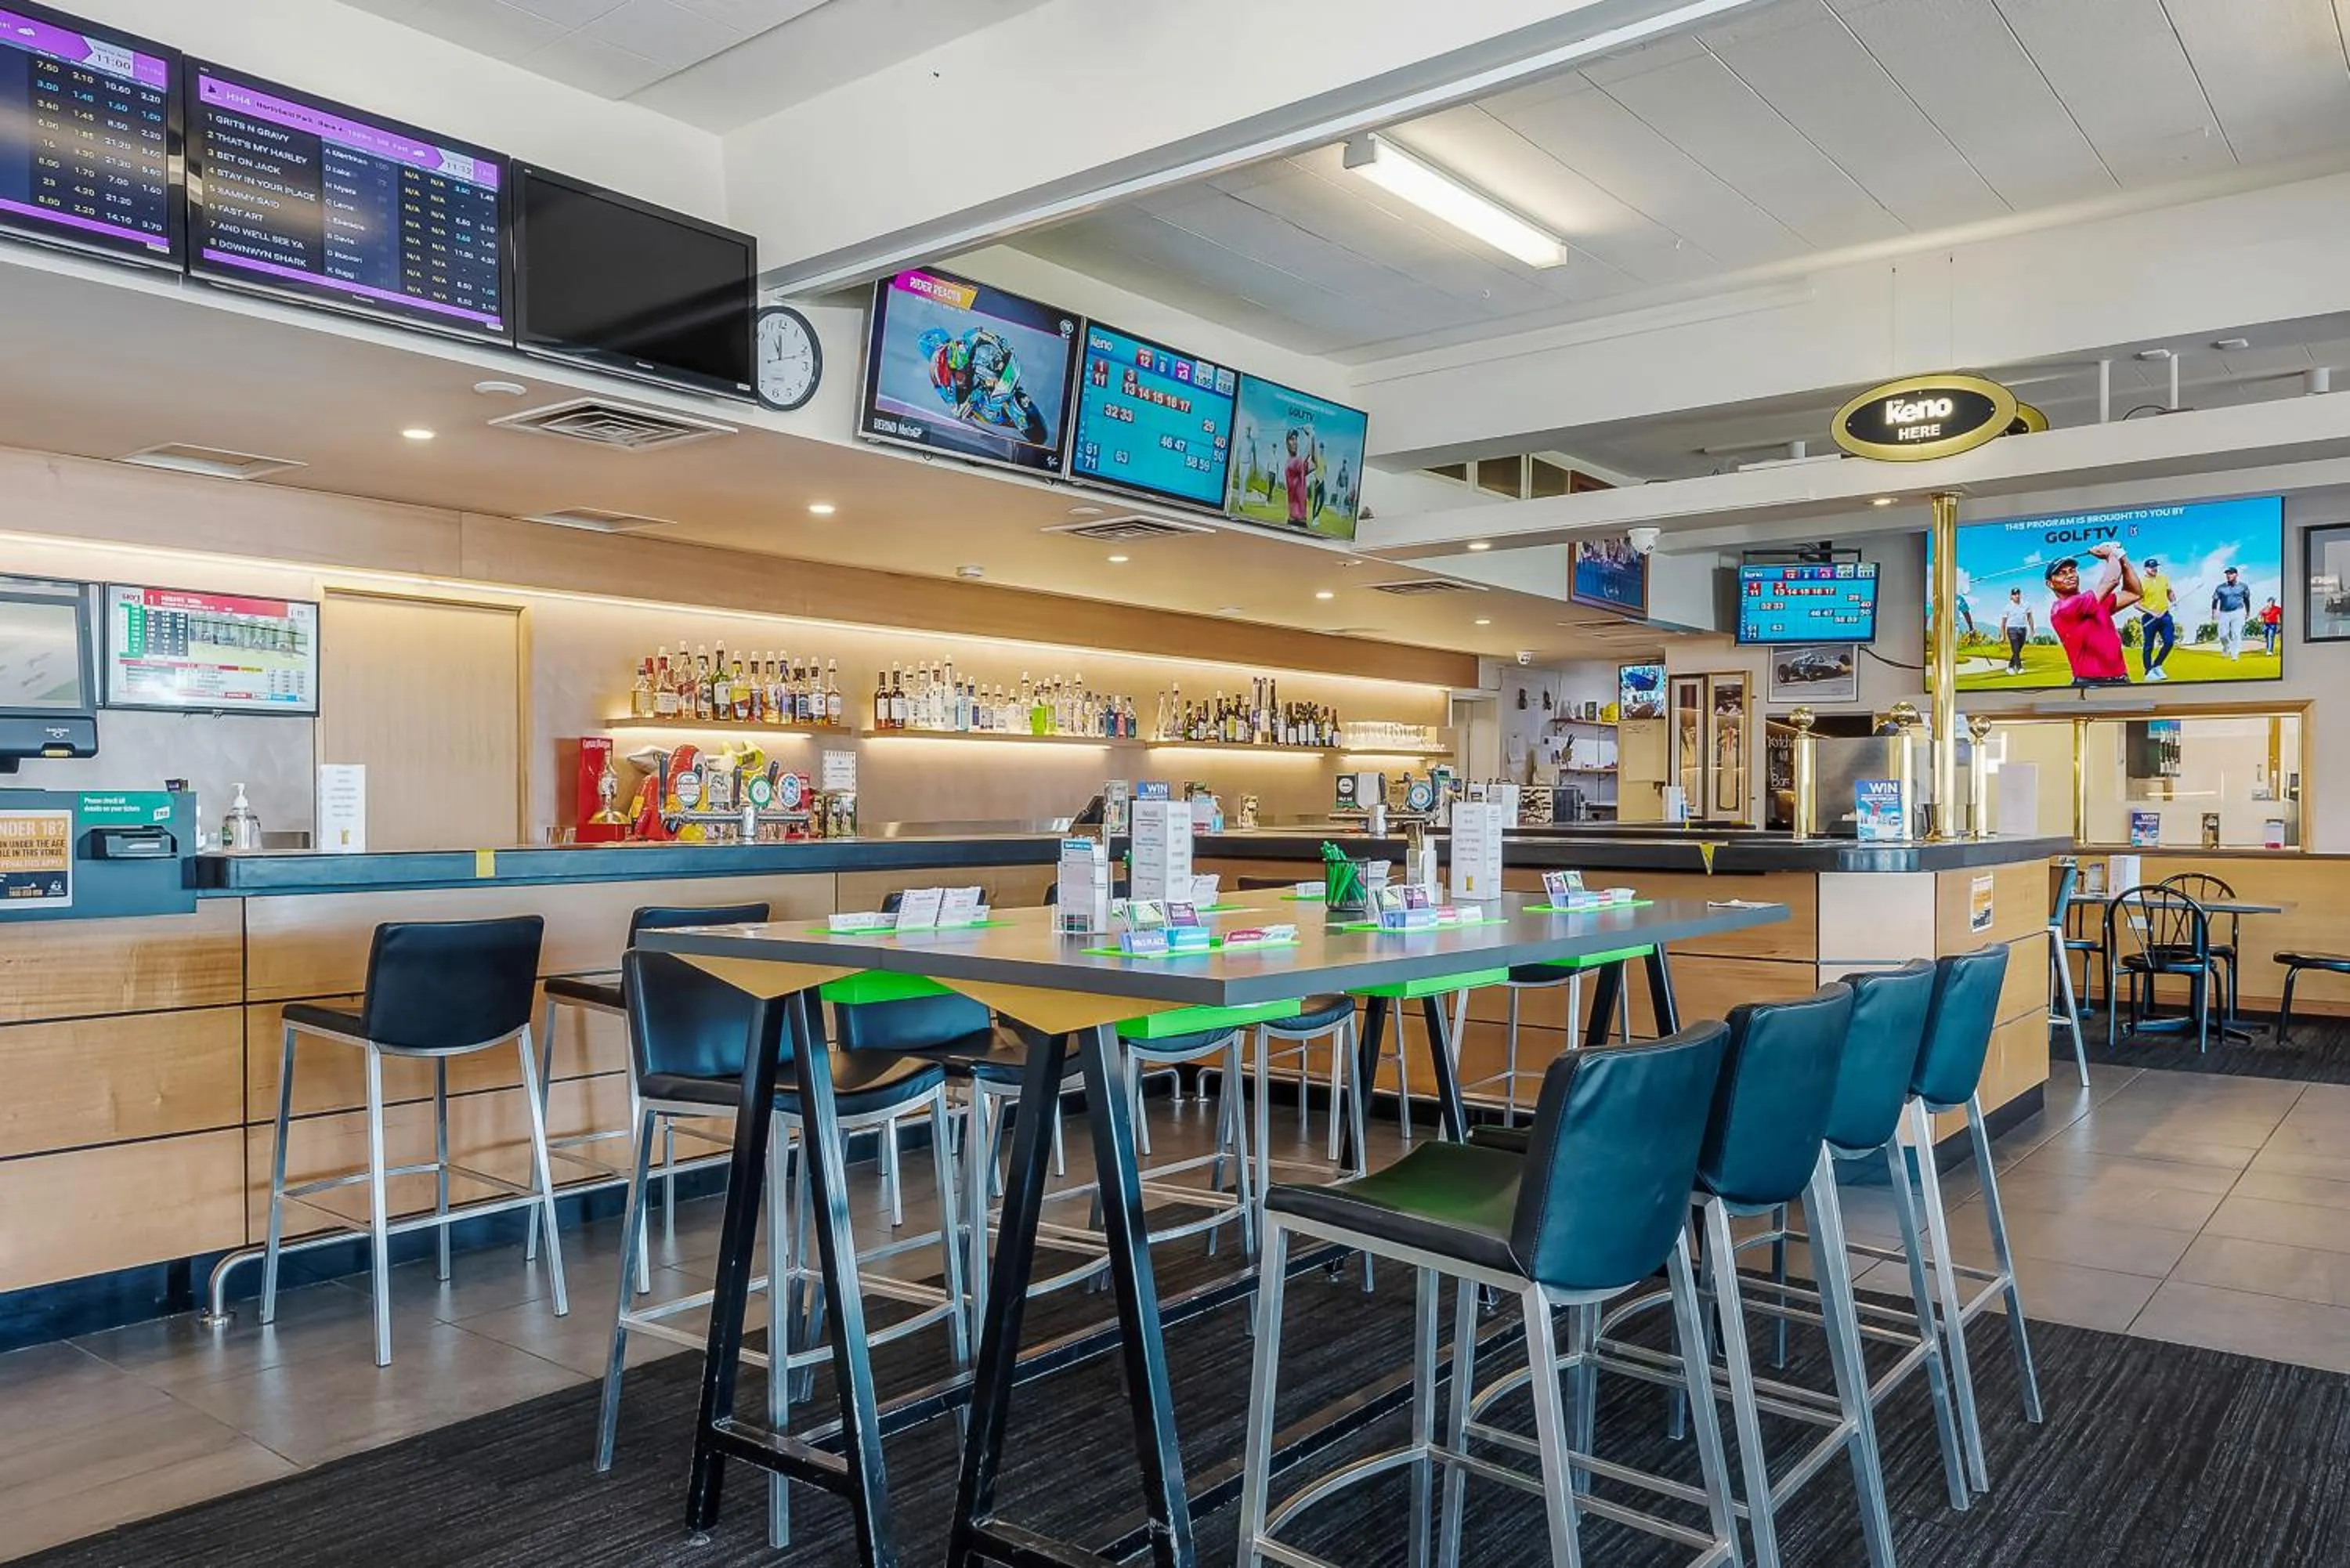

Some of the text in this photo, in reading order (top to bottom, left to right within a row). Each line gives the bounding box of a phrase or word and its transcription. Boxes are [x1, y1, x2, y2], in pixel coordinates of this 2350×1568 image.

[215, 115, 245, 131] GRITS
[257, 127, 289, 143] GRAVY
[253, 143, 269, 154] MY
[270, 147, 308, 164] HARLEY
[238, 157, 253, 168] ON
[255, 161, 281, 175] JACK
[216, 168, 242, 182] STAY
[244, 175, 255, 186] IN
[256, 179, 284, 194] YOUR
[284, 187, 316, 201] PLACE
[217, 186, 255, 203] SAMMY
[256, 197, 280, 209] SAID
[218, 204, 243, 216] FAST
[244, 211, 264, 222] ART
[219, 222, 240, 234] AND
[291, 239, 305, 250] YA
[273, 252, 307, 267] SHARK
[1089, 333, 1114, 352] Keno
[1140, 355, 1150, 367] 12
[1124, 383, 1136, 396] 13
[1105, 403, 1118, 417] 32
[1119, 409, 1133, 421] 33
[1885, 397, 1953, 425] Keno
[1202, 419, 1214, 432] 29
[1898, 424, 1940, 441] HERE
[1160, 435, 1173, 448] 46
[1174, 439, 1186, 452] 47
[1086, 443, 1128, 463] 61 63
[1186, 454, 1210, 471] 58 59
[2005, 523, 2025, 532] THIS
[2026, 517, 2074, 530] PROGRAM
[2087, 512, 2133, 524] BROUGHT
[2149, 508, 2171, 518] YOU
[2172, 506, 2185, 515] BY
[2044, 526, 2118, 544] GOLFTV
[1147, 784, 1167, 793] WIN
[1869, 782, 1898, 793] WIN
[42, 820, 64, 836] 18?
[37, 839, 49, 847] THE
[51, 839, 66, 847] AGE
[23, 848, 38, 857] THIS
